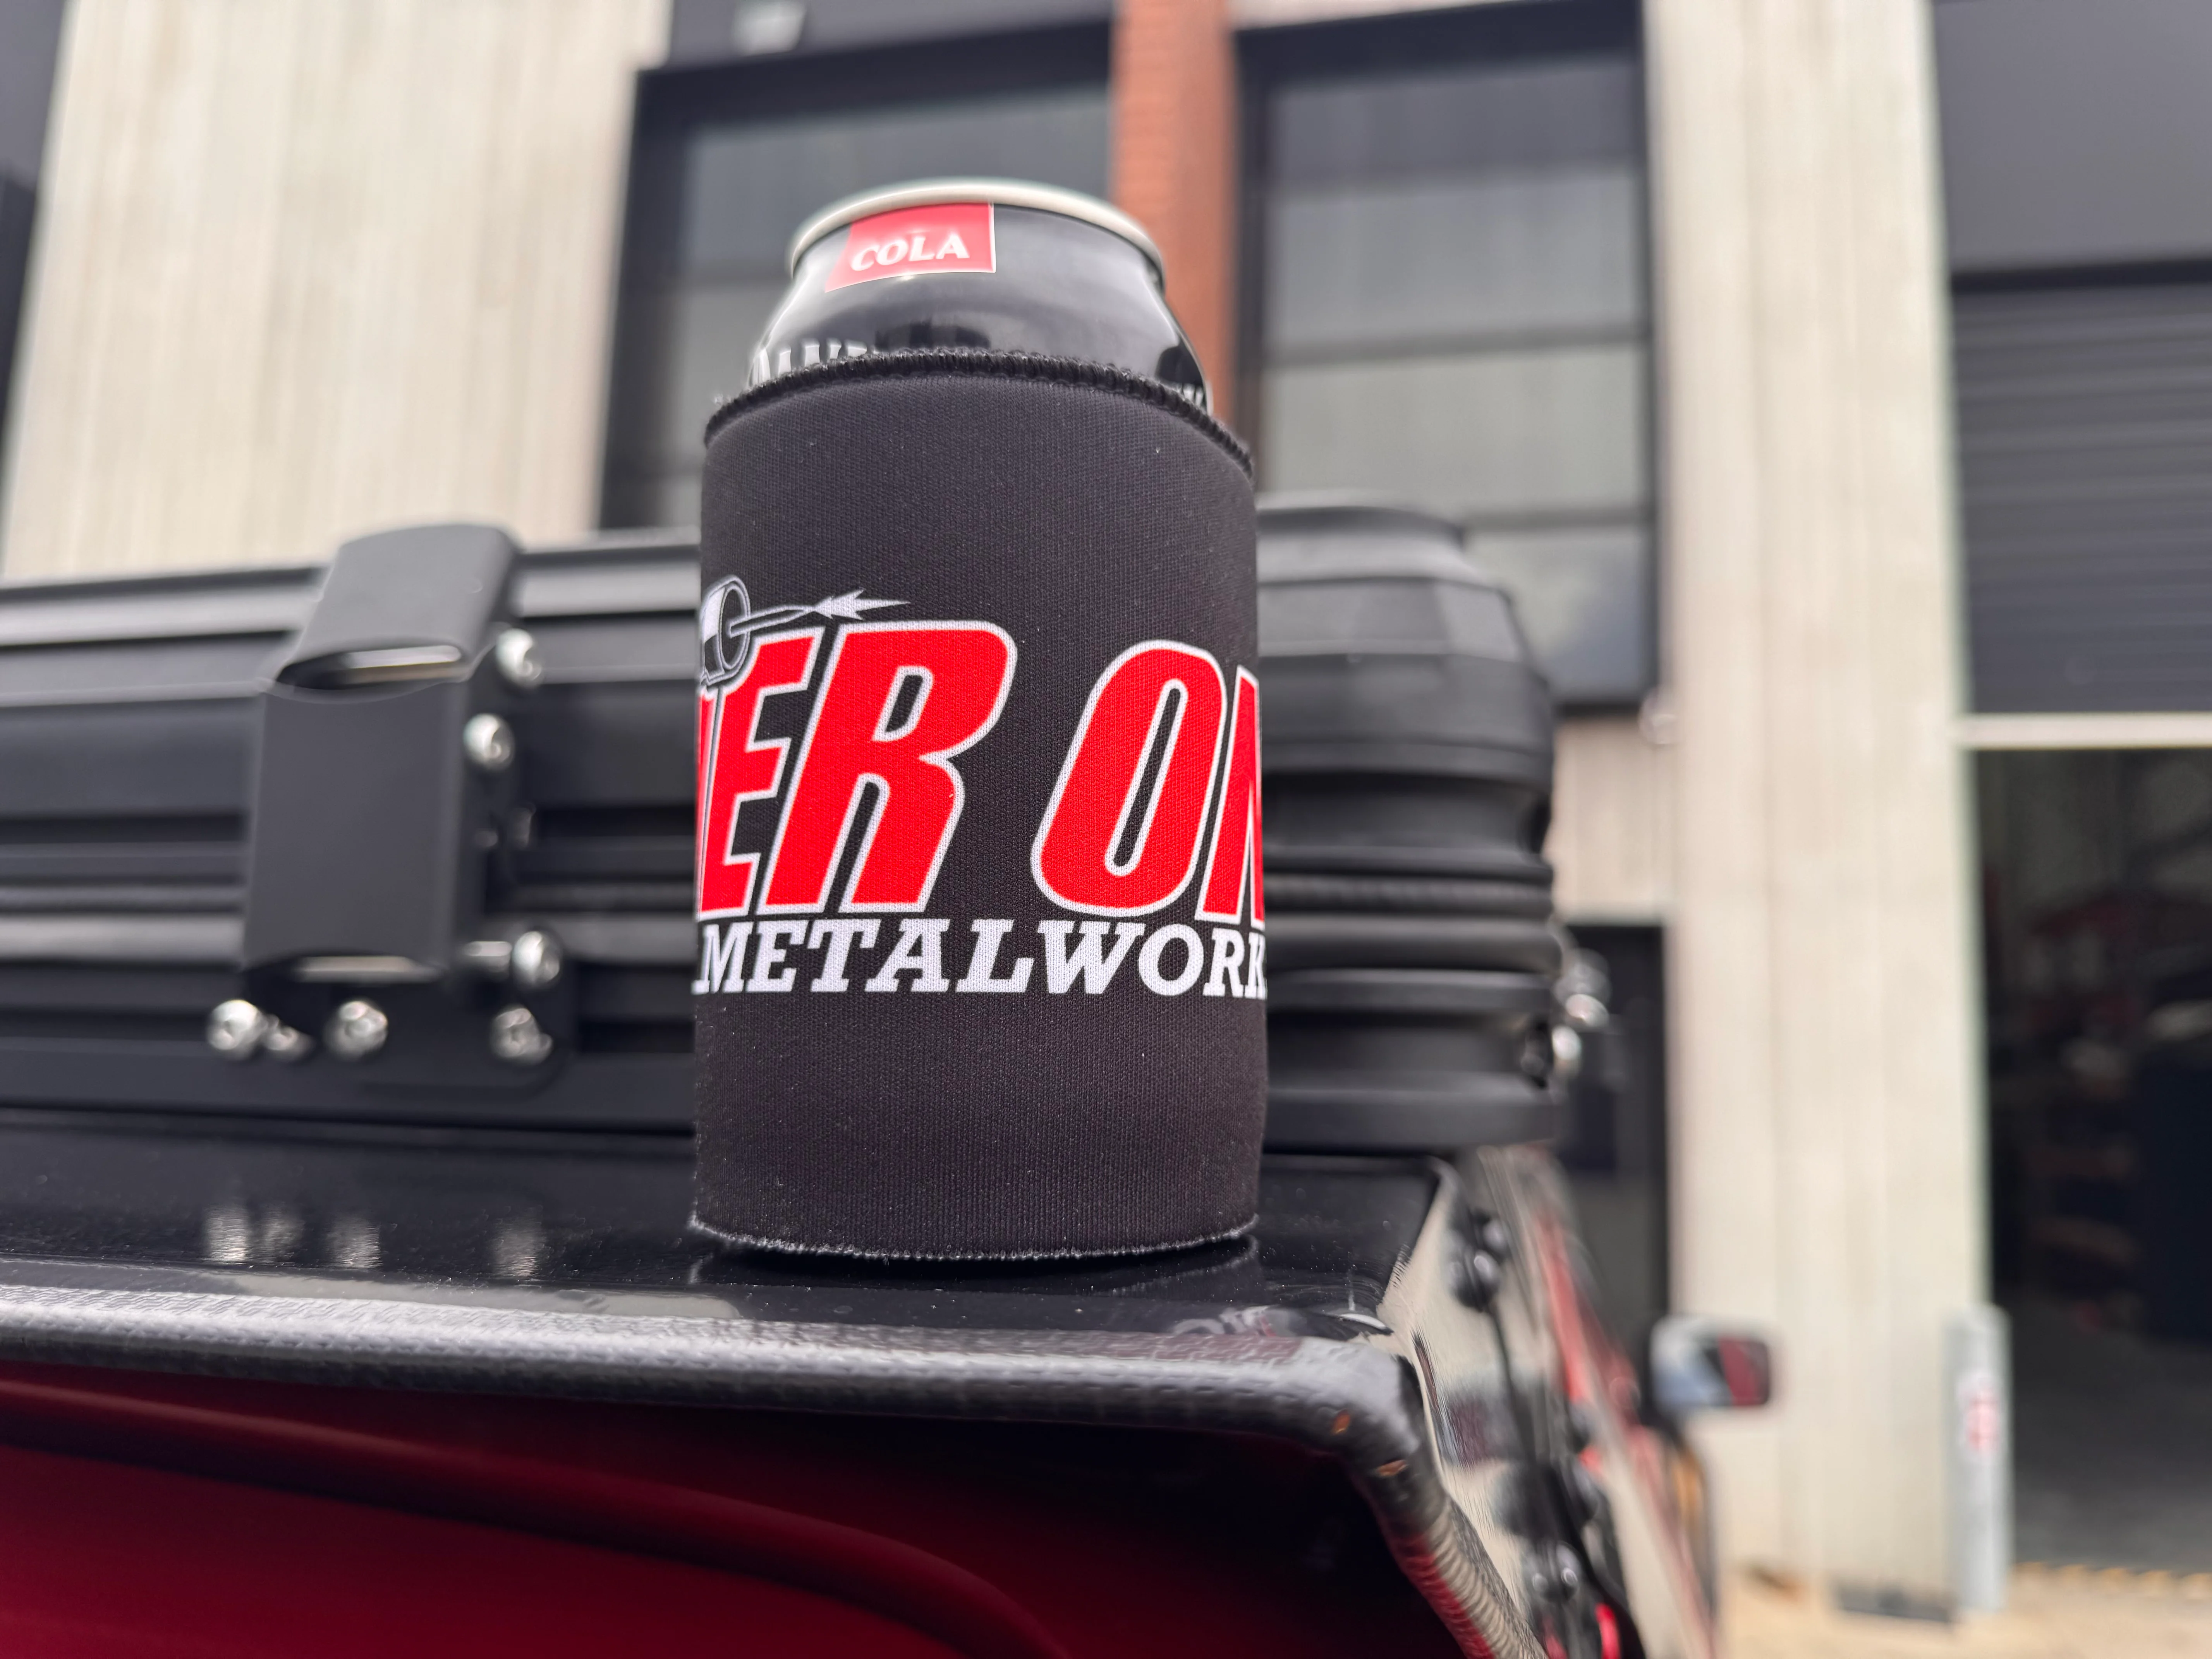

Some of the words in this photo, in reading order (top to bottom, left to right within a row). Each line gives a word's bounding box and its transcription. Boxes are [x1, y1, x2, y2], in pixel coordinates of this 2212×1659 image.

[850, 234, 970, 271] COLA
[696, 621, 1017, 920] ER
[692, 918, 1267, 1000] METALWORK
